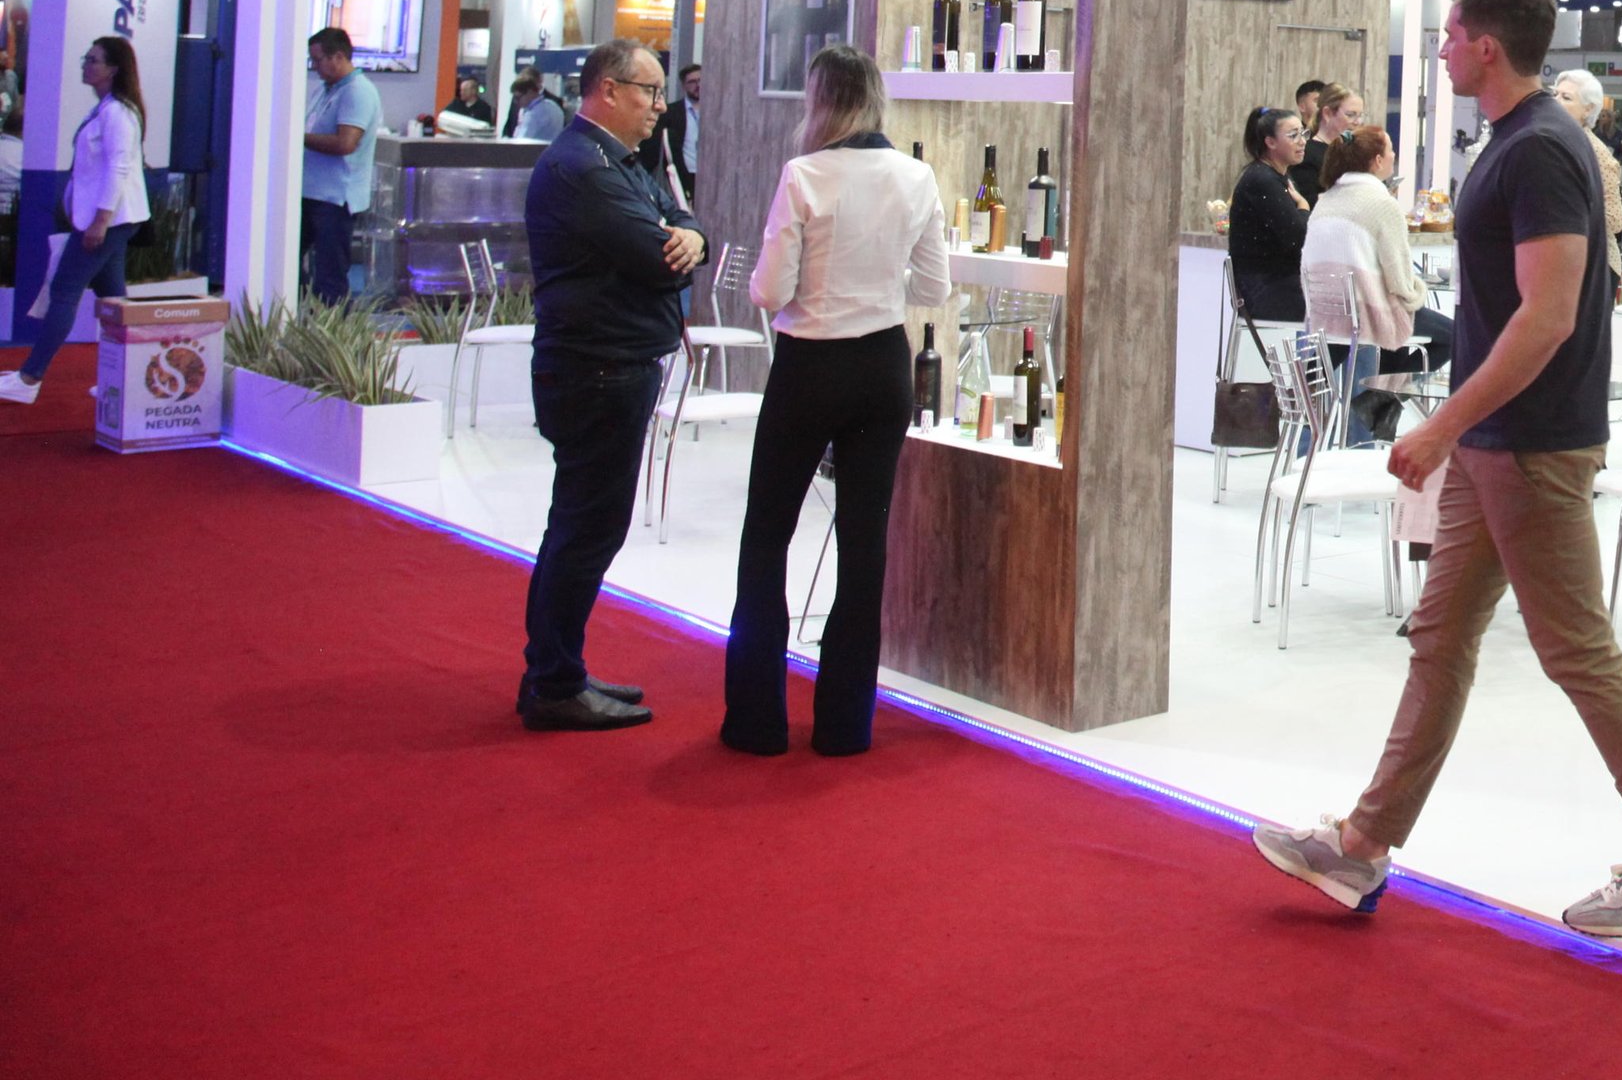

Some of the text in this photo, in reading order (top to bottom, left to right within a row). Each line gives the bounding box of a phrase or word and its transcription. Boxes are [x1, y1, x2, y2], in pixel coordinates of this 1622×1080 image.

[154, 308, 200, 319] Comum
[145, 404, 202, 418] PEGADA
[145, 417, 201, 431] NEUTRA
